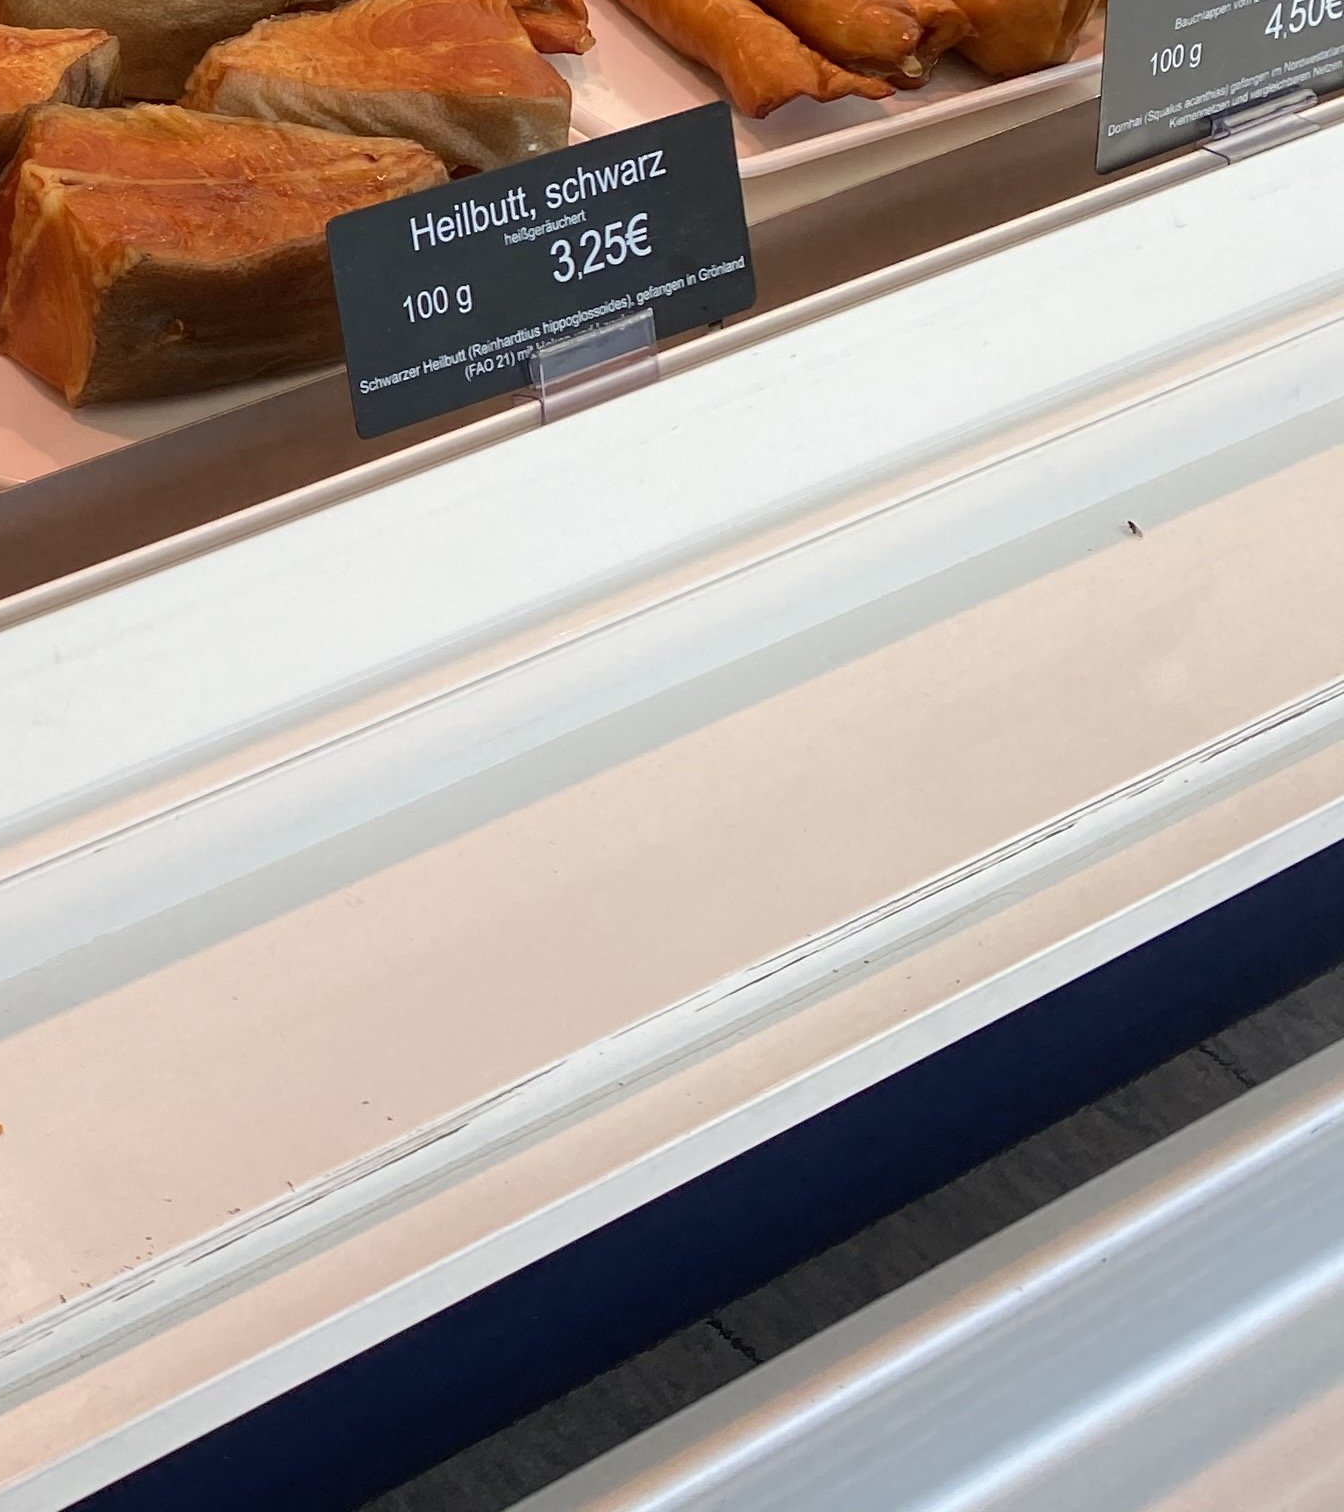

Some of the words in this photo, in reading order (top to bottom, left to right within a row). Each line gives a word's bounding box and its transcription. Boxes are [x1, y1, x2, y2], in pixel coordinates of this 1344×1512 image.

[1151, 44, 1184, 75] 100
[1190, 43, 1201, 67] g
[410, 187, 536, 250] Heilbutt,
[546, 151, 666, 208] schwarz
[504, 210, 586, 245] heißgeräuchert
[551, 213, 651, 282] 3,25€
[403, 286, 448, 322] 100
[457, 285, 472, 313] g
[360, 366, 420, 393] Schwarzer
[423, 350, 467, 373] Heilbutt
[468, 327, 541, 360] (Reinhardtius
[543, 294, 634, 334] hippoglossoides),
[637, 279, 684, 305] gefangen
[687, 274, 696, 285] in
[699, 256, 745, 280] Grönland
[465, 359, 494, 381] (FAO
[496, 351, 515, 368] 21)
